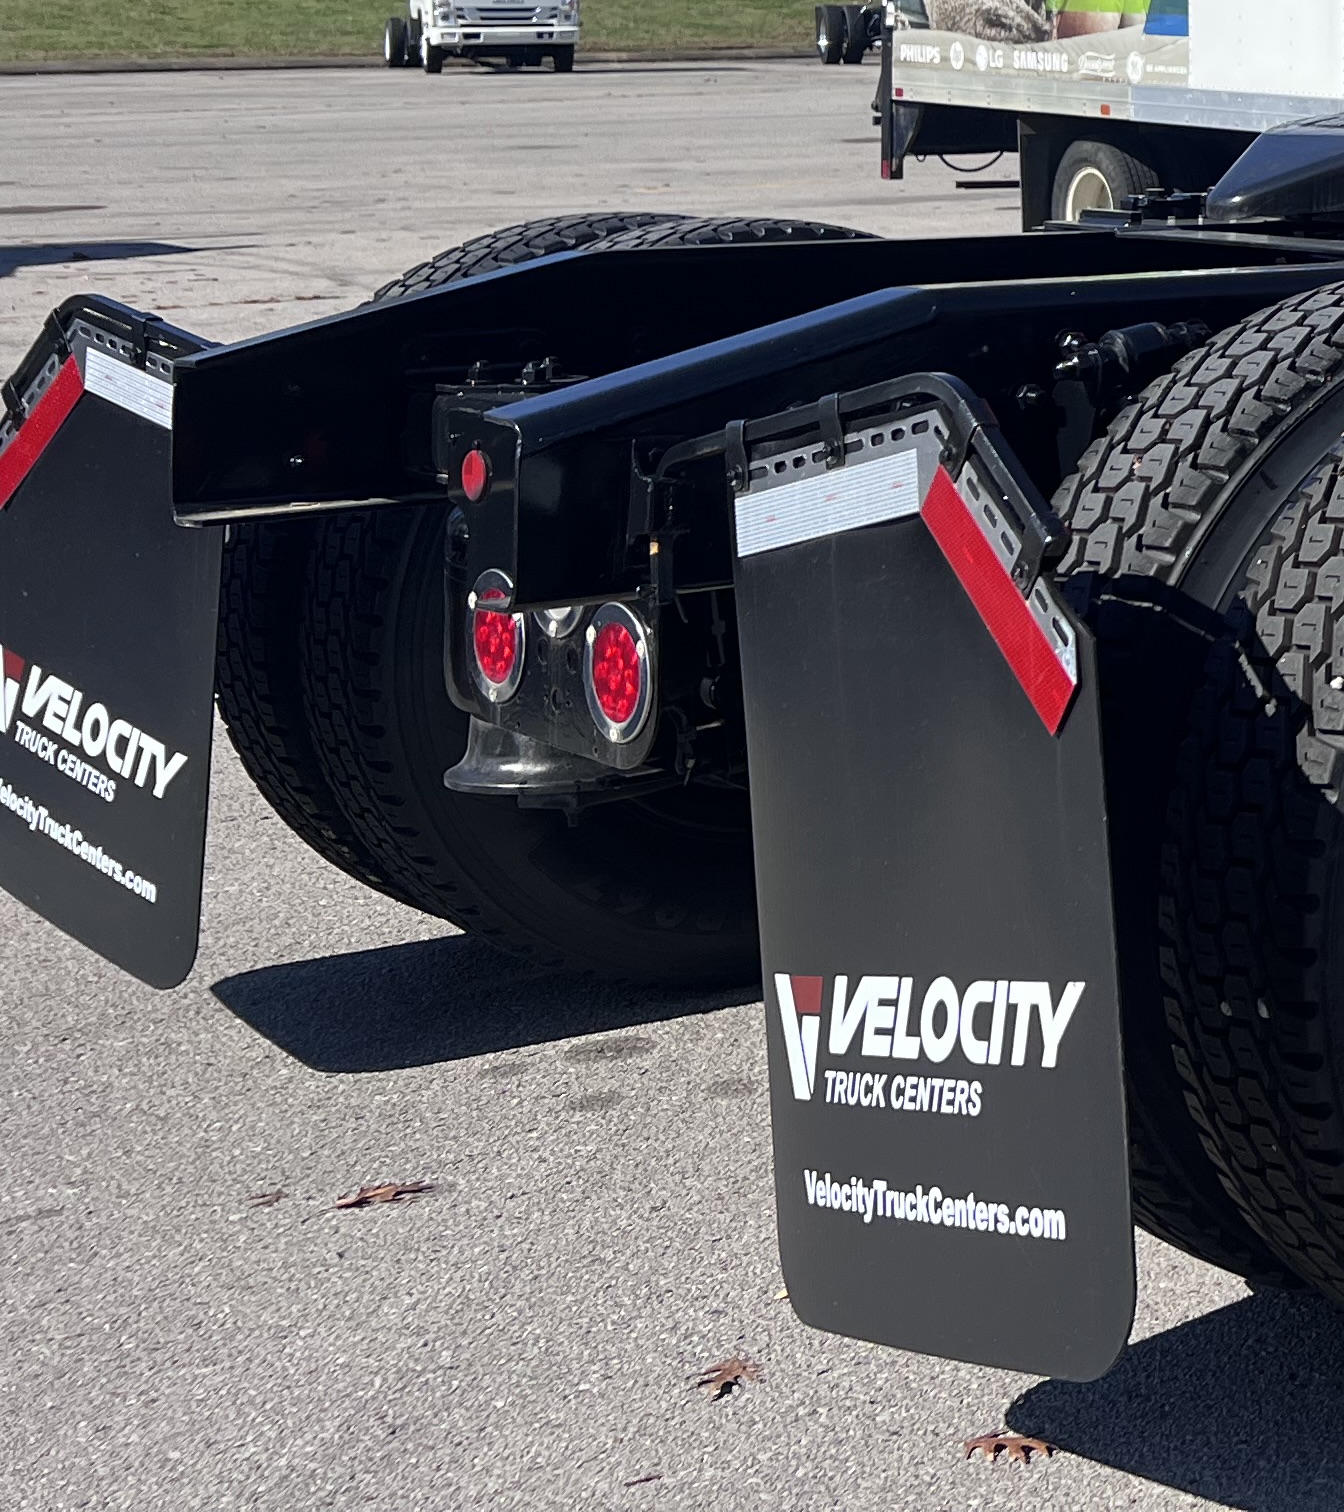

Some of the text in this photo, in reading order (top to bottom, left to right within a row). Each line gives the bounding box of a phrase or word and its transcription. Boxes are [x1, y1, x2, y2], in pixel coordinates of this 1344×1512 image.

[900, 44, 941, 64] PHILIPS
[989, 48, 1004, 68] LG
[1013, 49, 1069, 73] SAMSUNG
[21, 664, 188, 799] VELOCITY
[15, 720, 117, 803] TRUCK CENTERS
[829, 975, 1086, 1068] VELOCITY
[824, 1070, 983, 1117] TRUCK CENTERS
[804, 1169, 1066, 1241] VelocityTruckCenters.com
